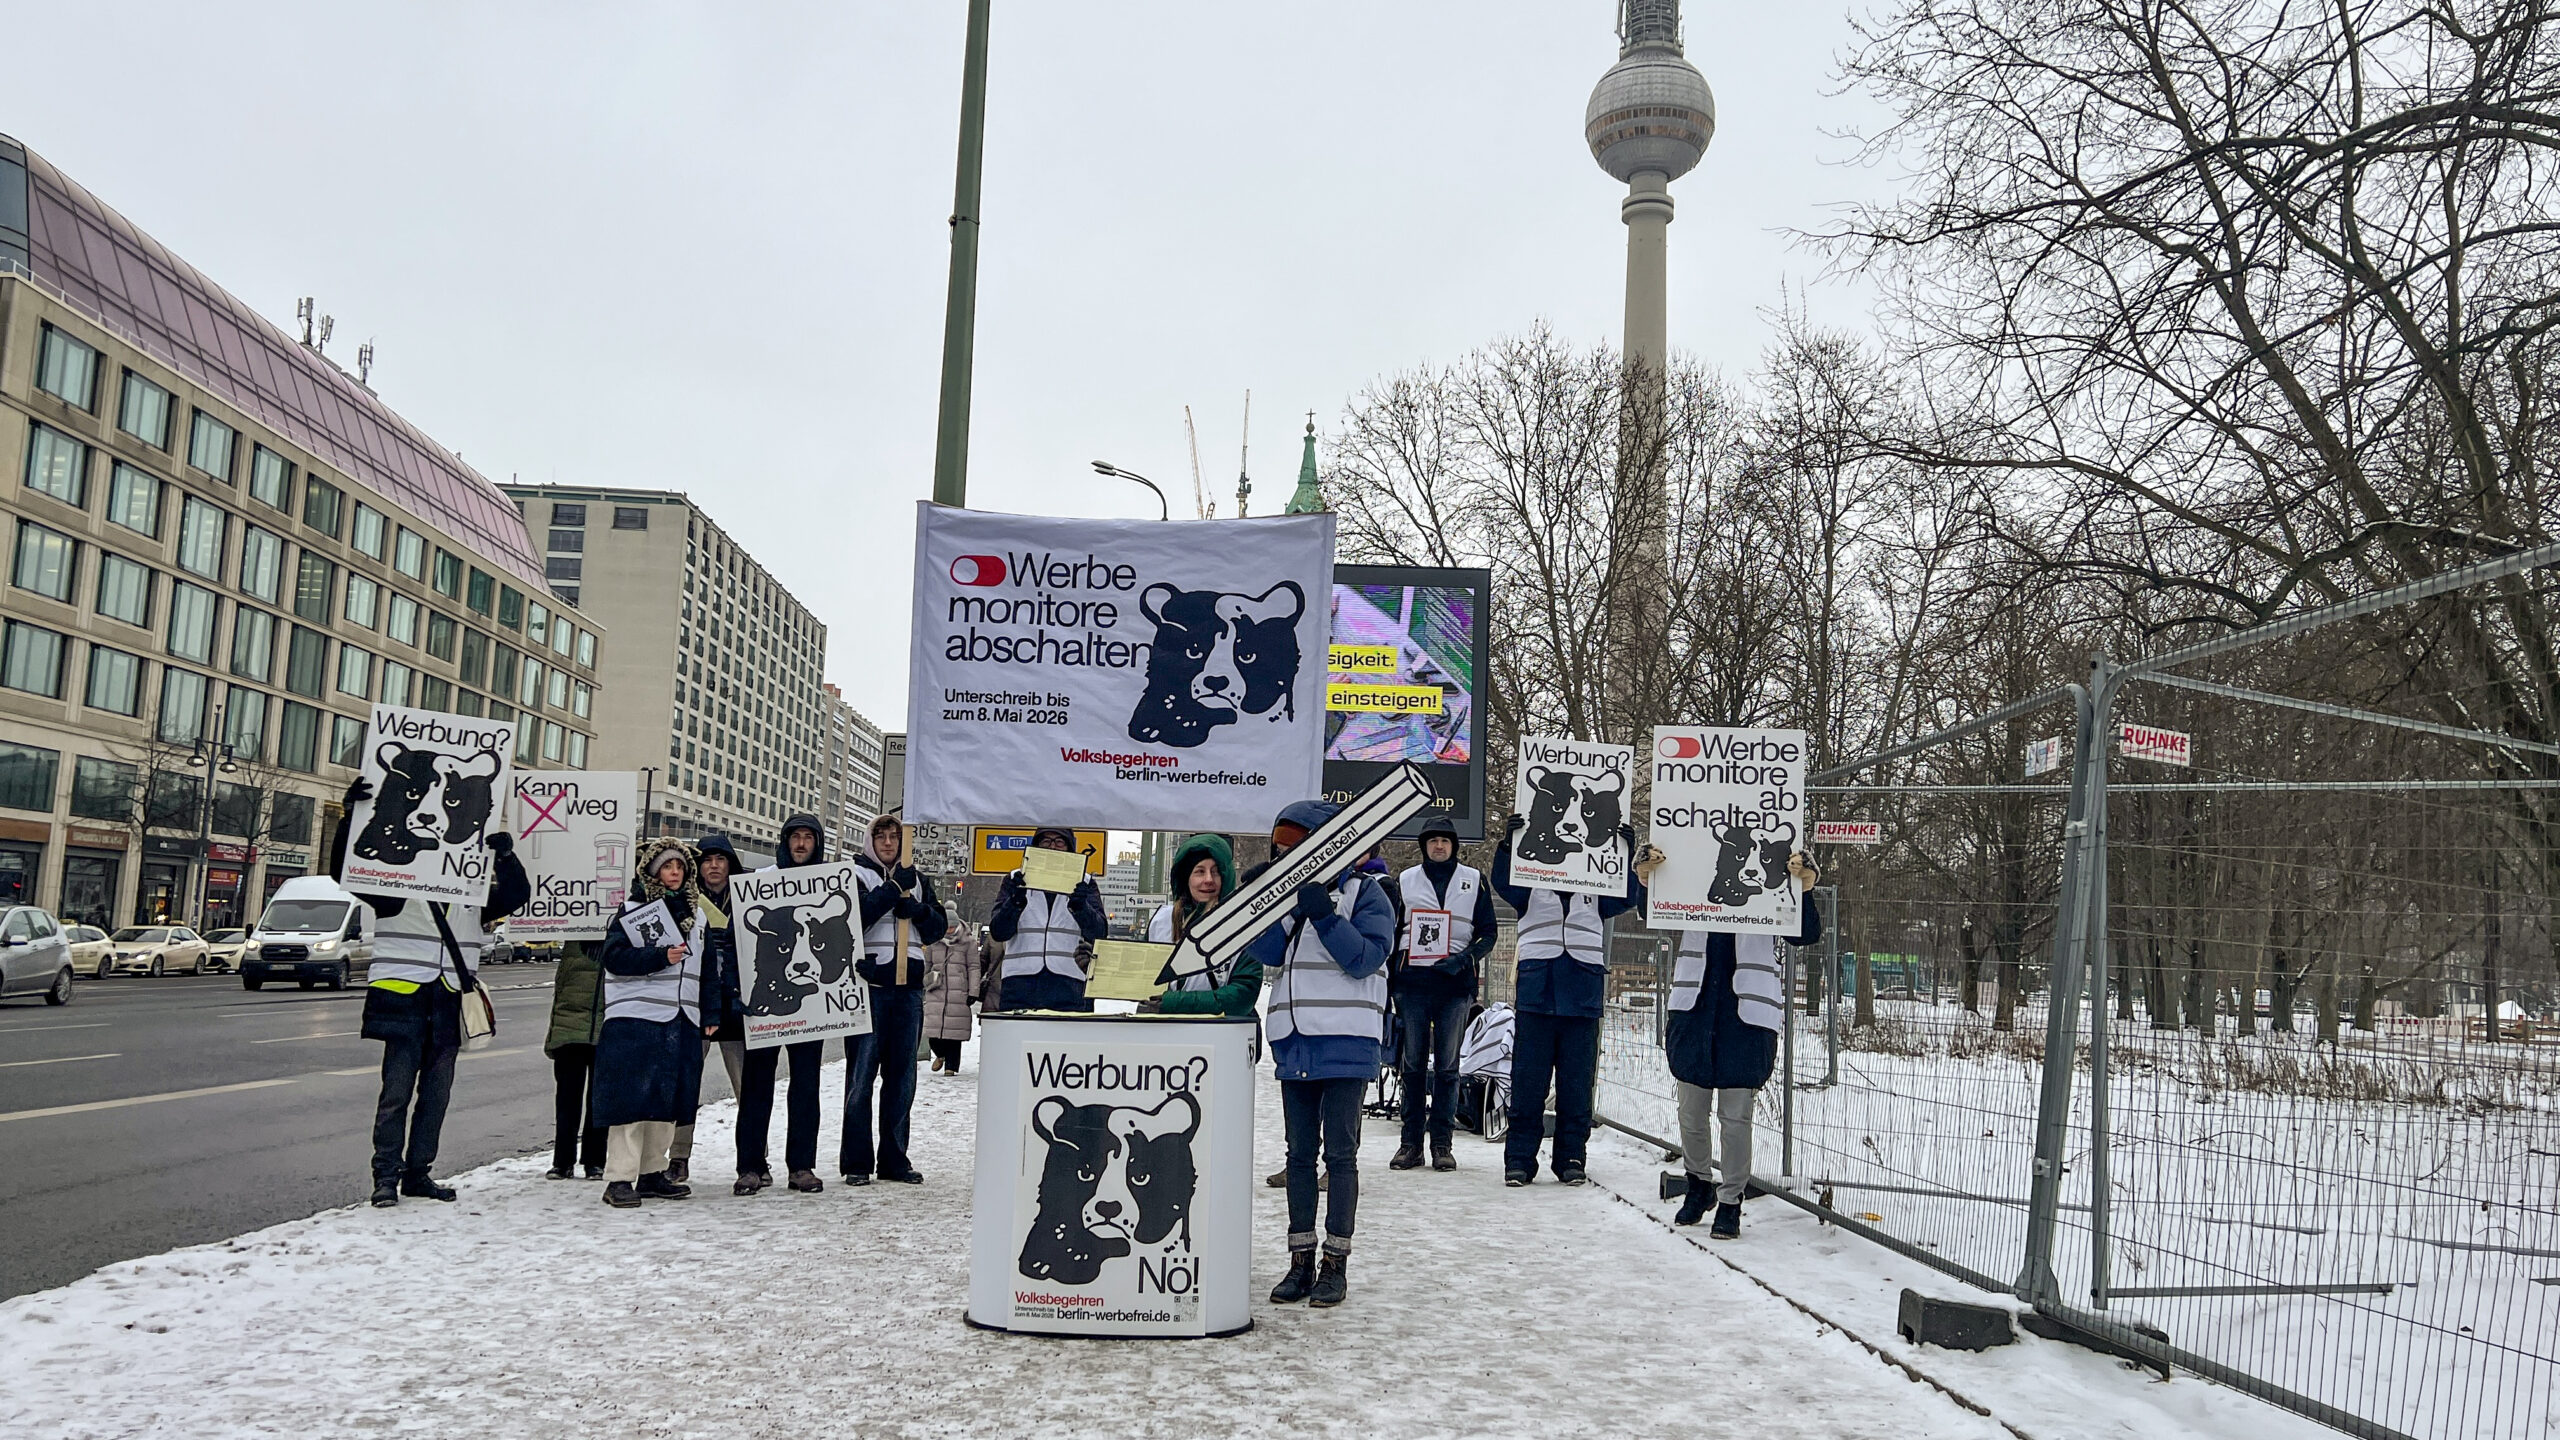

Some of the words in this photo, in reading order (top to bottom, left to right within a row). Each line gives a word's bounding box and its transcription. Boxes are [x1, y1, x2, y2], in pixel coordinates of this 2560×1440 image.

[1008, 552, 1136, 591] Werbe
[949, 591, 1118, 628] monitore
[945, 626, 1154, 668] abschalten
[944, 688, 1042, 705] Unterschreib
[1047, 692, 1070, 707] bis
[1332, 690, 1436, 709] einsteigen!
[943, 709, 974, 720] zum
[977, 707, 990, 721] 8.
[993, 708, 1022, 722] Mai
[1026, 709, 1068, 725] 2026
[377, 710, 511, 752] Werbung?
[2124, 727, 2187, 752] RUHNKE
[1060, 747, 1179, 768] Volksbegehren
[1524, 742, 1630, 770] Werbung?
[1700, 734, 1799, 762] Werbe
[1116, 766, 1267, 786] berlin-werbefrei.de
[1657, 761, 1788, 786] monitore
[514, 776, 579, 798] Kann
[567, 799, 617, 821] weg
[1759, 786, 1798, 812] ab
[1655, 802, 1780, 829] schalten
[1818, 824, 1876, 835] RUHNKE
[348, 865, 416, 880] Volksbegehren
[441, 851, 488, 880] Nö!
[1250, 889, 1277, 915] Jetzt
[1275, 826, 1359, 894] unterschreiben!
[1514, 865, 1568, 877] Volksbegehren
[1587, 853, 1623, 875] Nö!
[378, 878, 463, 896] berlin-werbefrei.de
[734, 868, 852, 902] Werbung?
[1539, 875, 1606, 888] berlin-werbefrei.de
[1652, 900, 1722, 913] Volksbegehren
[537, 925, 607, 933] berlin-werbefrei.d
[1685, 911, 1774, 925] berlin-werbefrei.de
[825, 987, 865, 1014] Nö!
[748, 1019, 807, 1033] Volksbegehren
[777, 1022, 850, 1037] berlin-werbefrei.de
[1027, 1052, 1208, 1093] Werbung?
[1138, 1256, 1199, 1294] Nö!
[1015, 1291, 1104, 1308] Volksbegehren
[1057, 1307, 1170, 1322] berlin-werbefrei.de
